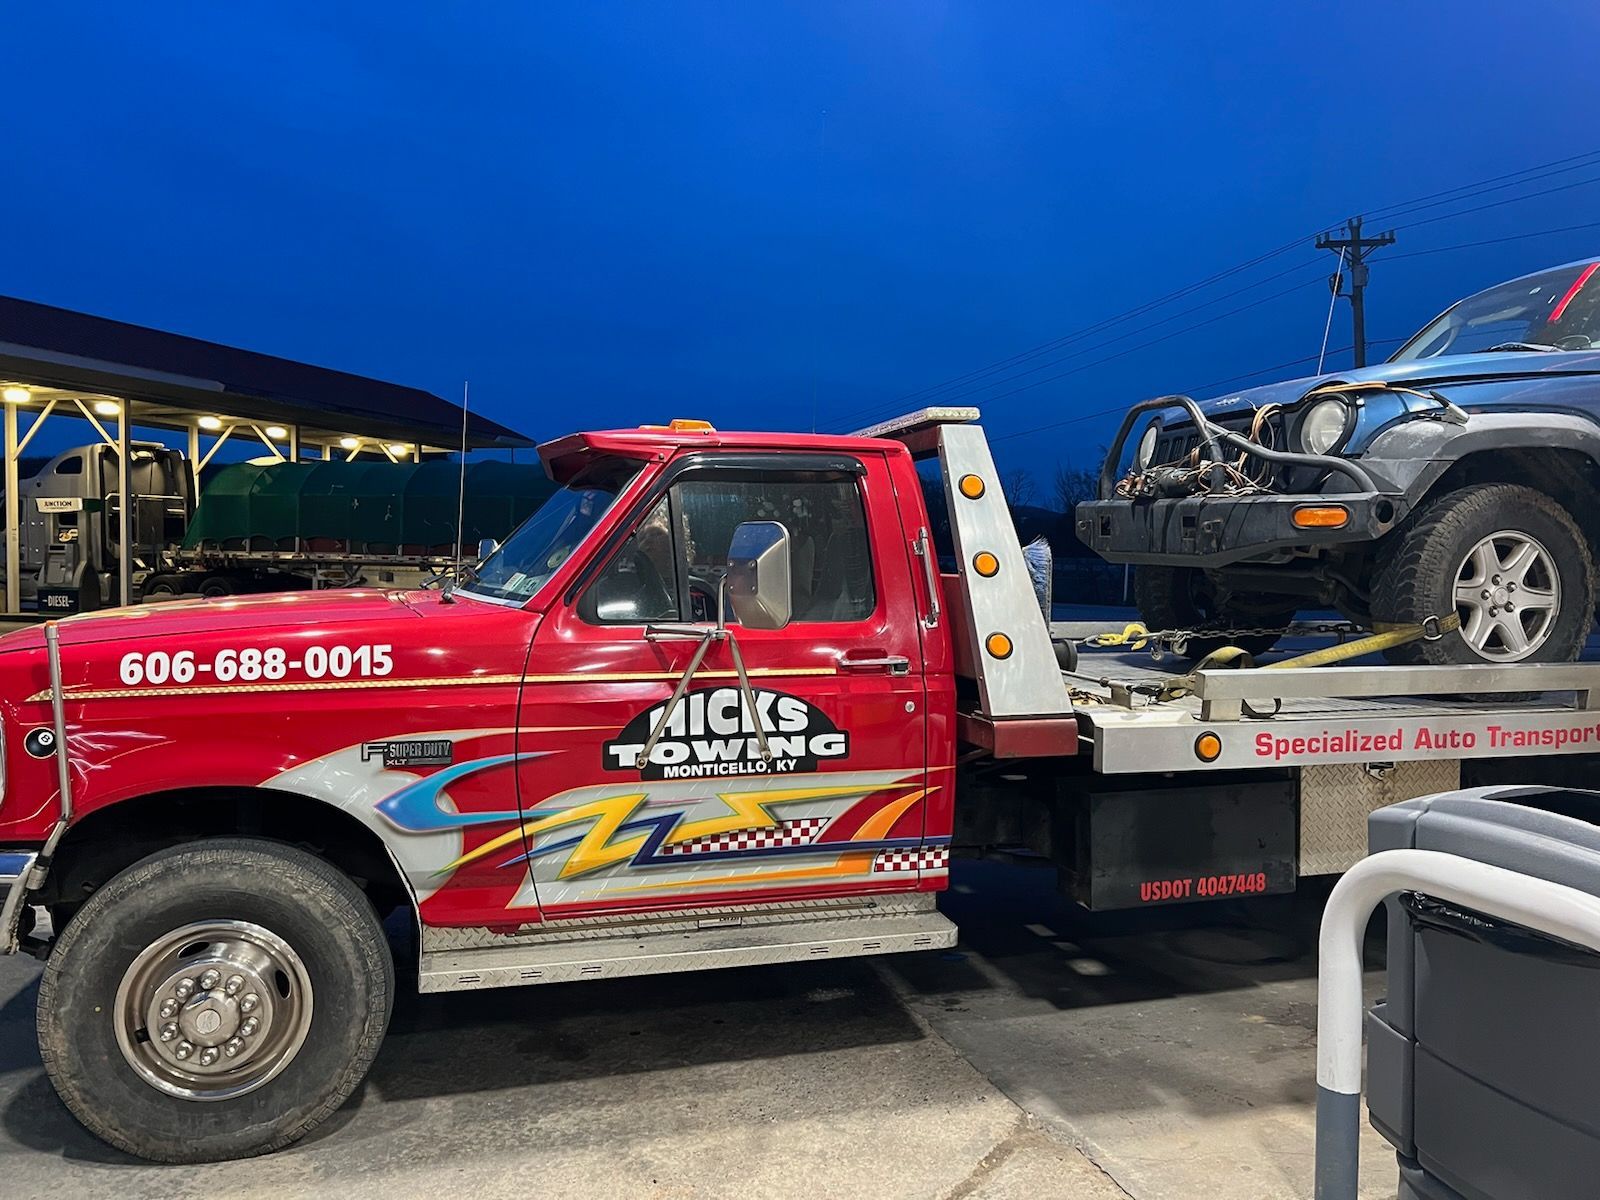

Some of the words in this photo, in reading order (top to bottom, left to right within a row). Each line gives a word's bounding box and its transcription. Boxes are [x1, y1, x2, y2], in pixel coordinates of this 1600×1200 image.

[47, 594, 70, 607] DIESEL
[119, 644, 394, 686] 606-688-0015
[650, 687, 809, 737] HICKS
[423, 741, 450, 757] DUTY
[608, 733, 846, 767] TOWING
[1254, 728, 1403, 760] Specialized
[1413, 727, 1476, 750] Auto
[663, 761, 772, 778] MONTICELLO,
[776, 758, 797, 771] KY
[1140, 879, 1193, 901] USDOT
[1197, 872, 1266, 896] 4047448
